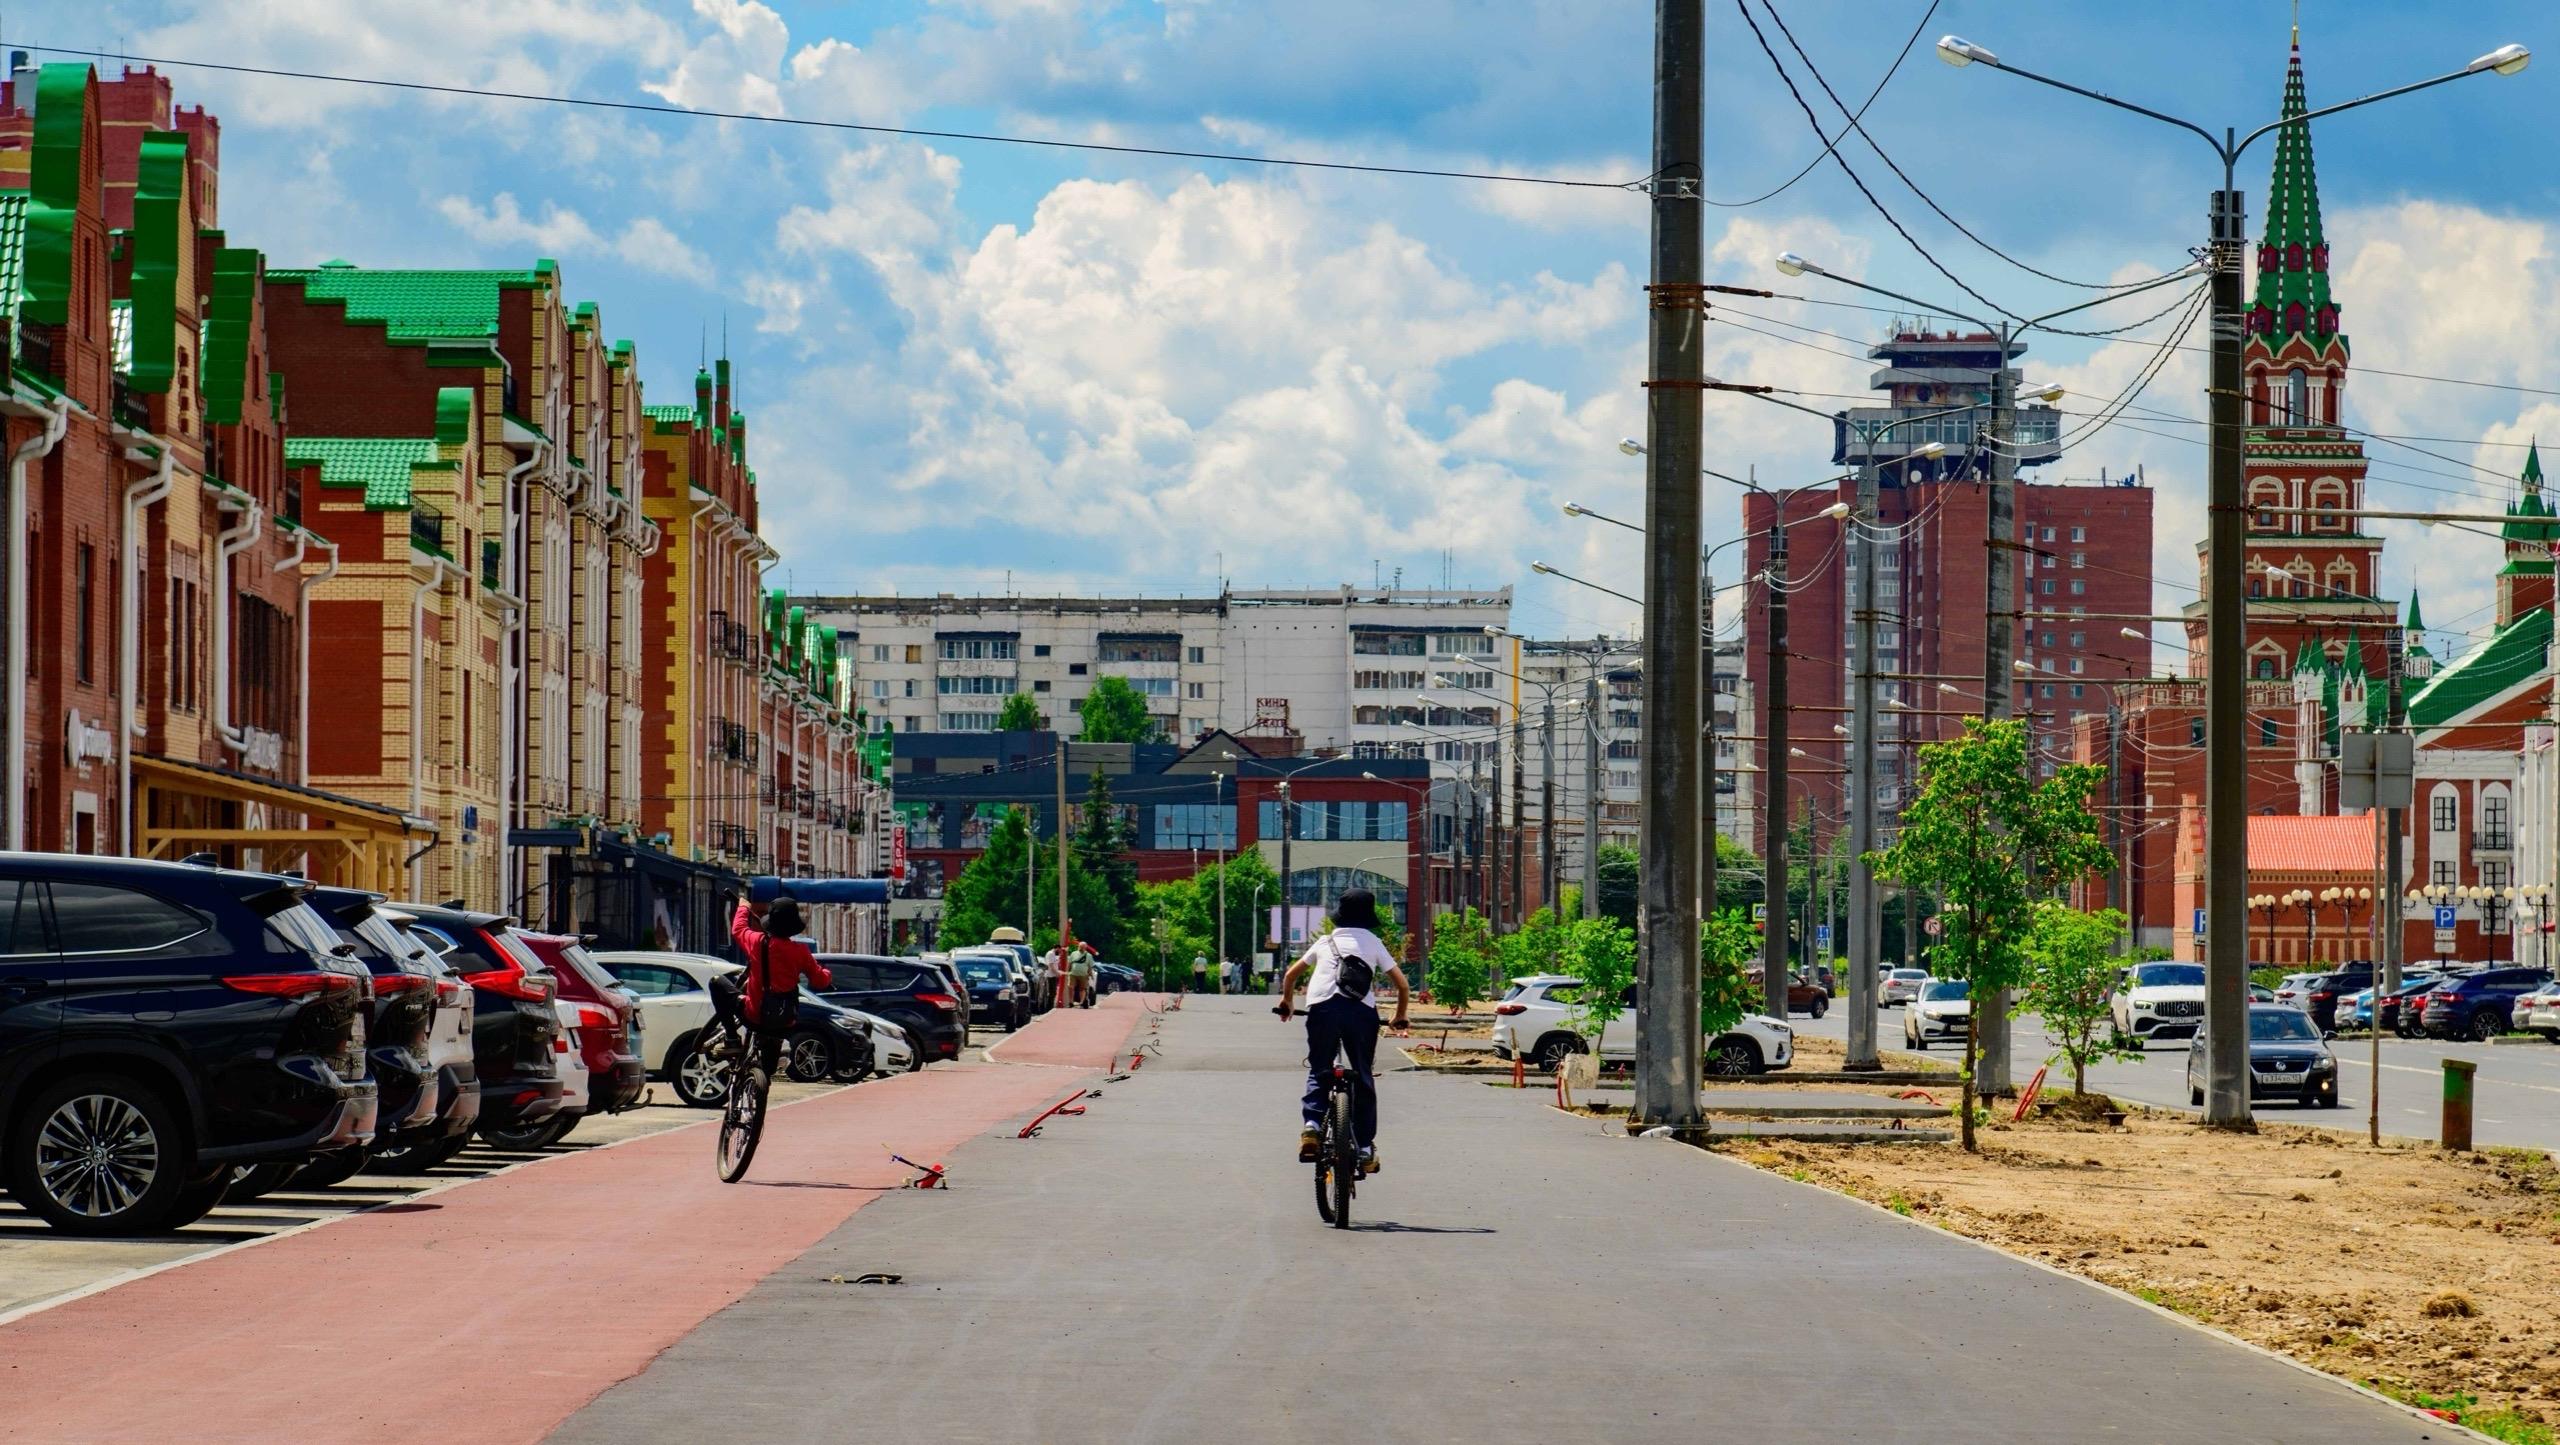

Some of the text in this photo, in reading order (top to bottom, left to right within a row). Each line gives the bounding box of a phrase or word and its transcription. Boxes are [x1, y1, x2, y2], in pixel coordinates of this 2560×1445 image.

[1256, 698, 1288, 708] КИНО
[895, 827, 904, 868] SPAR
[2440, 909, 2452, 926] P
